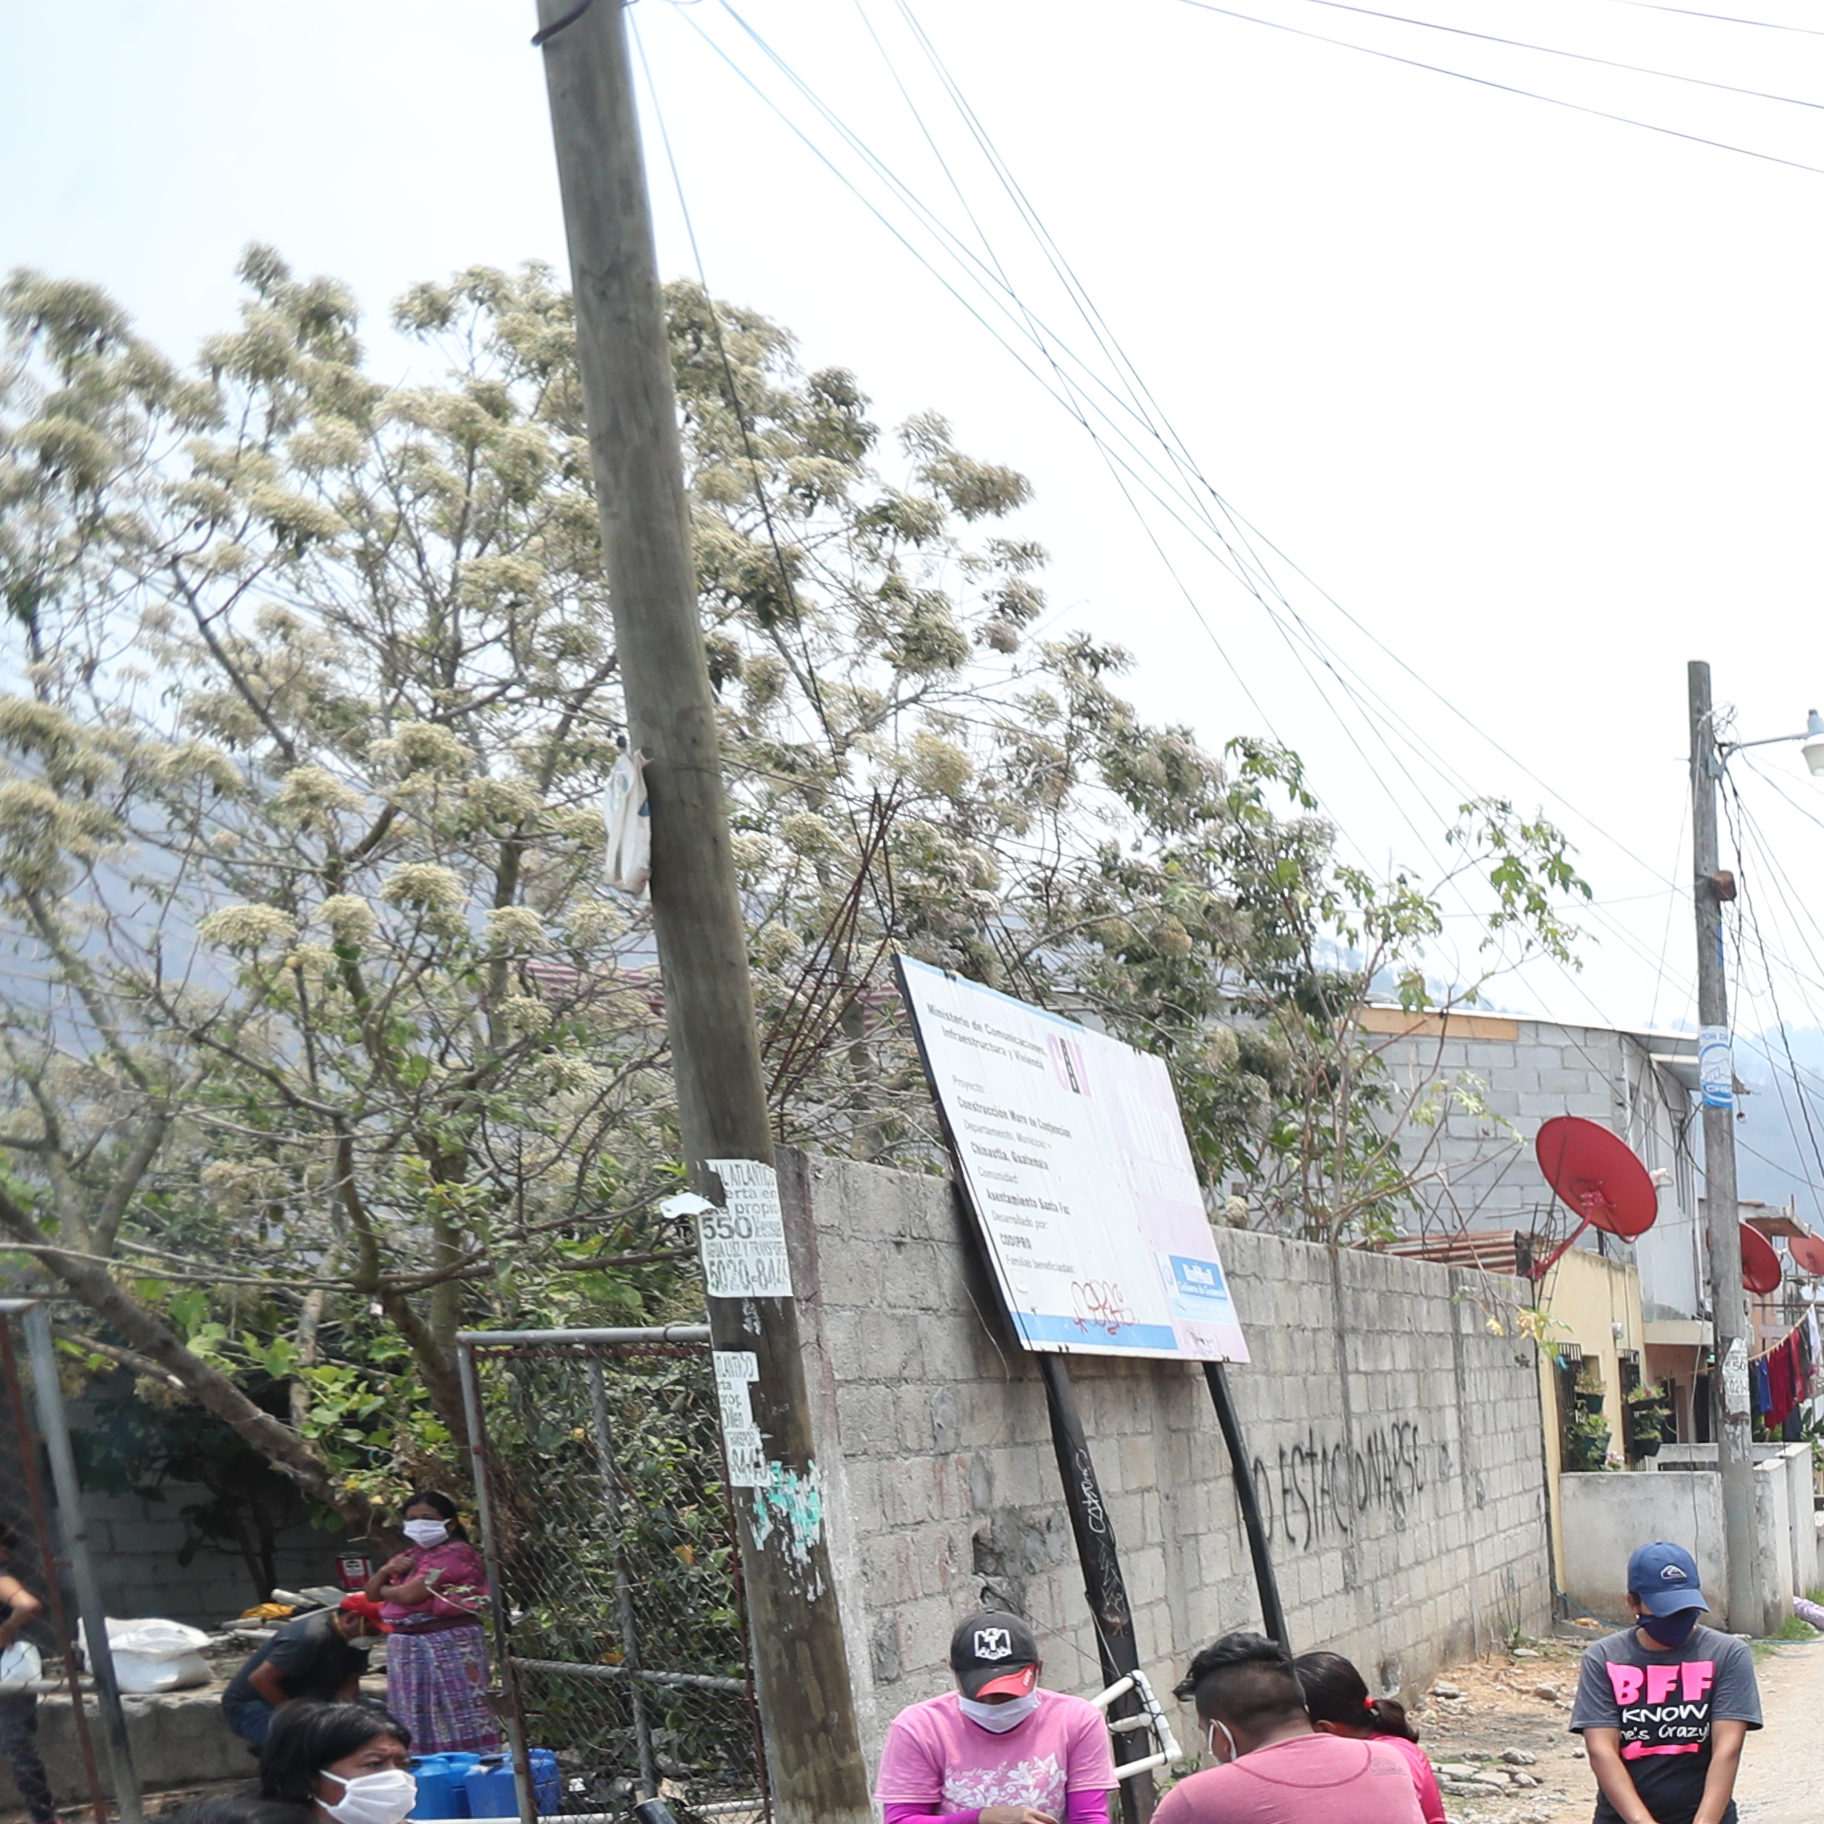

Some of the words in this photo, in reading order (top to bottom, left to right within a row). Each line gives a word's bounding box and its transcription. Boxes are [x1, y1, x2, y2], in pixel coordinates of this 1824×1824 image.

[926, 1002, 969, 1028] Ministerio
[972, 1019, 983, 1032] de
[941, 1025, 1006, 1056] Infraestructura
[1007, 1049, 1014, 1061] y
[1014, 1049, 1045, 1070] Vivienda
[1011, 1151, 1050, 1171] Guatemala
[762, 1190, 777, 1199] en
[702, 1216, 753, 1240] 550
[1605, 1661, 1714, 1706] BFF
